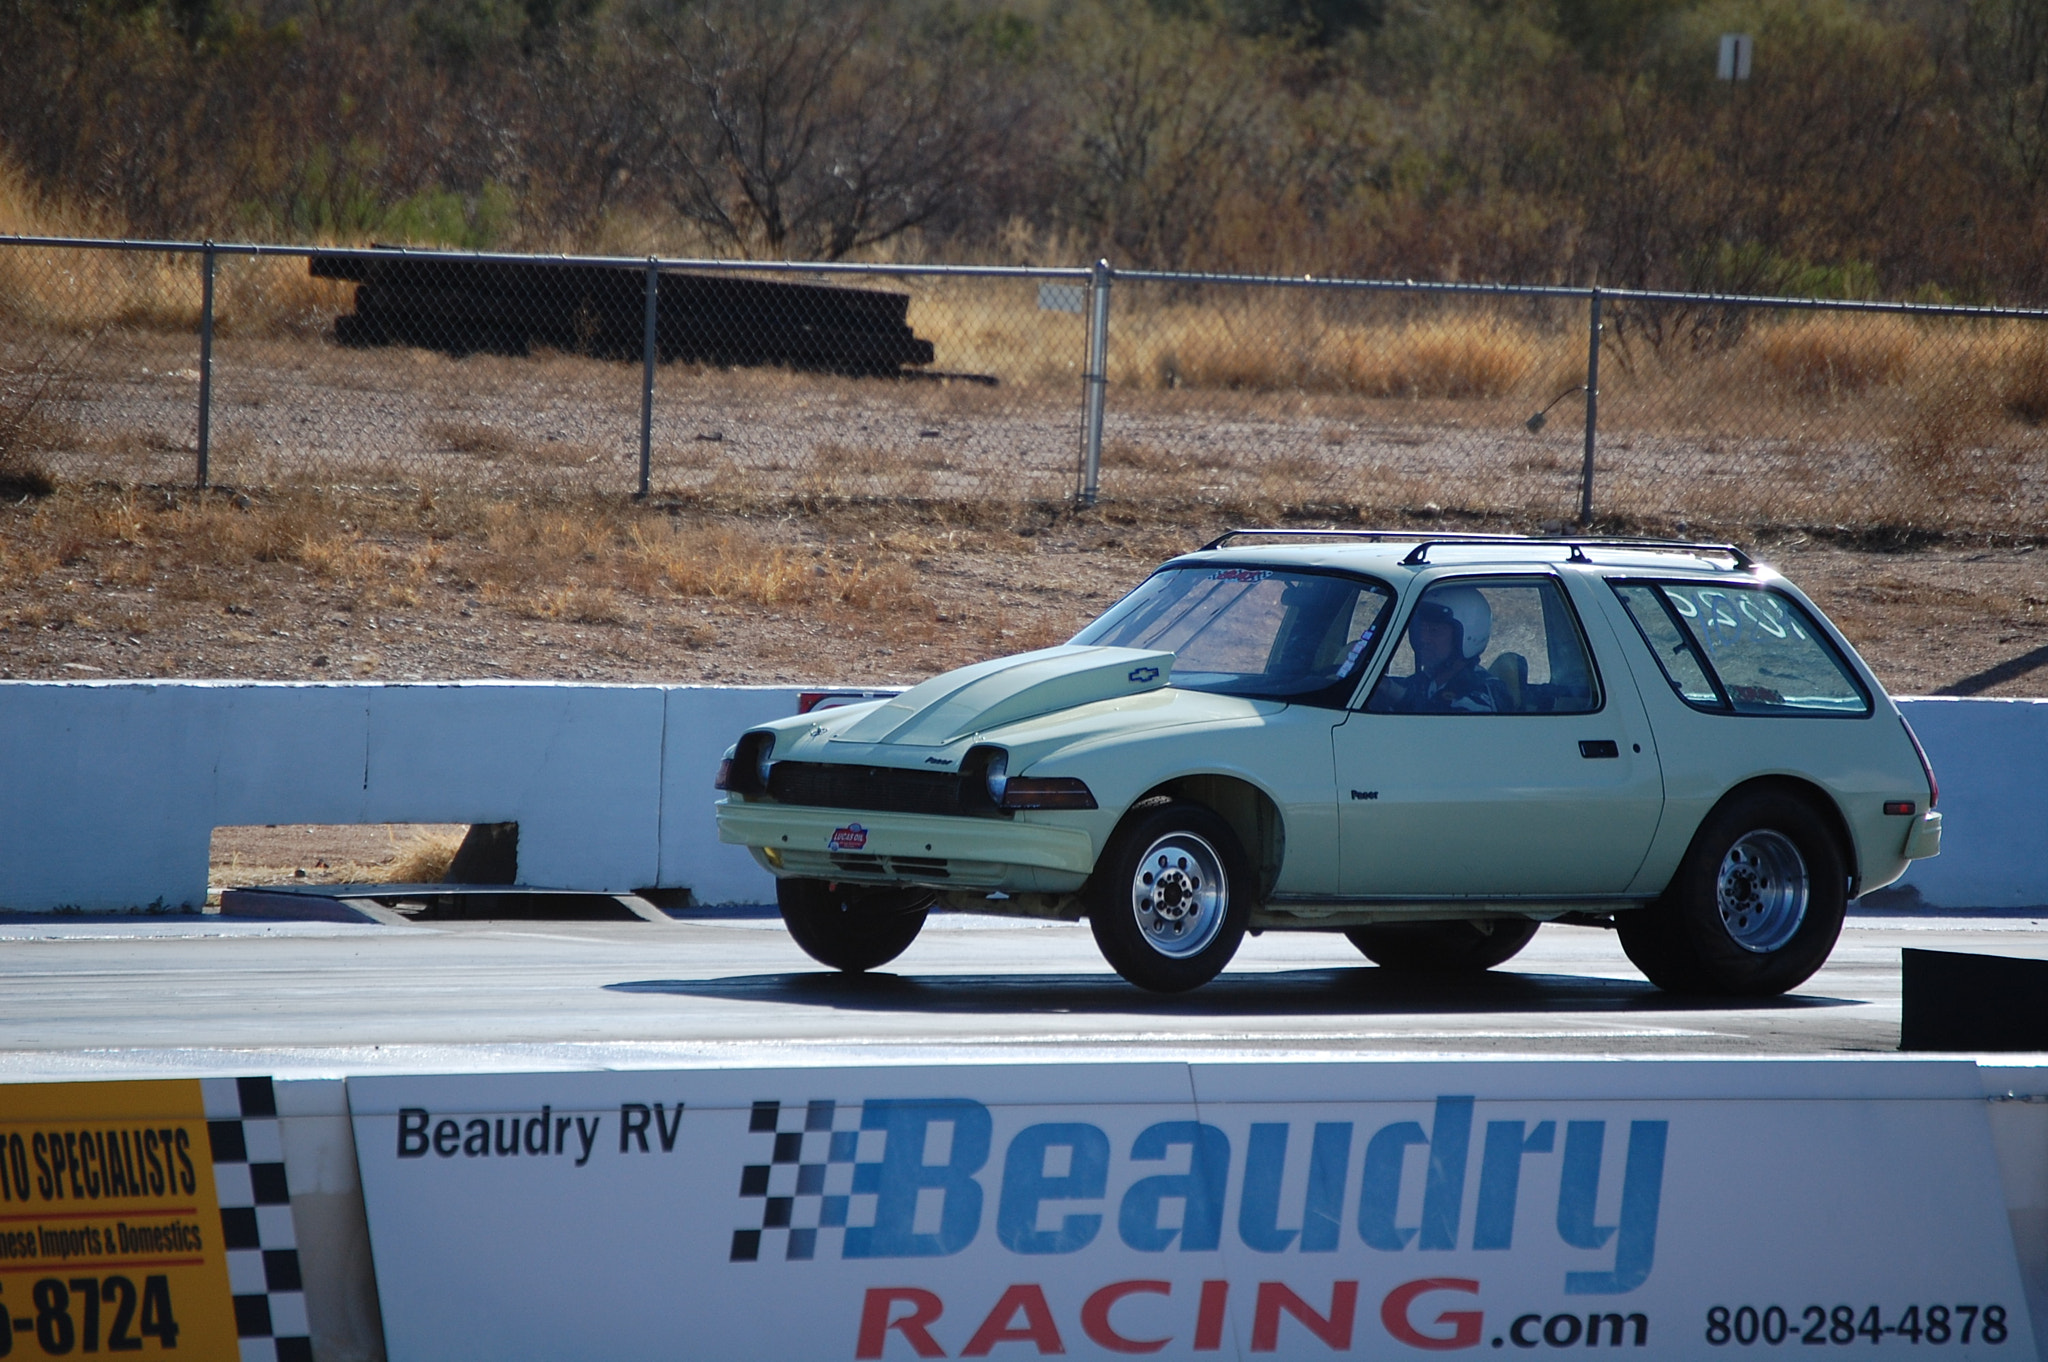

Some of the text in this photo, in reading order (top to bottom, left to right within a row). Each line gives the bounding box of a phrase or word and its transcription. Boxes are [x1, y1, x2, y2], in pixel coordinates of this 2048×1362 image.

[1351, 789, 1379, 801] Pacer
[833, 832, 863, 842] LUCAS OIL
[397, 1102, 685, 1167] Beaudry RV
[32, 1127, 197, 1202] SPECIALISTS
[842, 1095, 1669, 1296] Beaudry
[38, 1224, 102, 1261] Imports
[105, 1227, 116, 1255] &
[117, 1219, 203, 1254] Domestics
[1703, 1303, 2008, 1347] 800-284-4878
